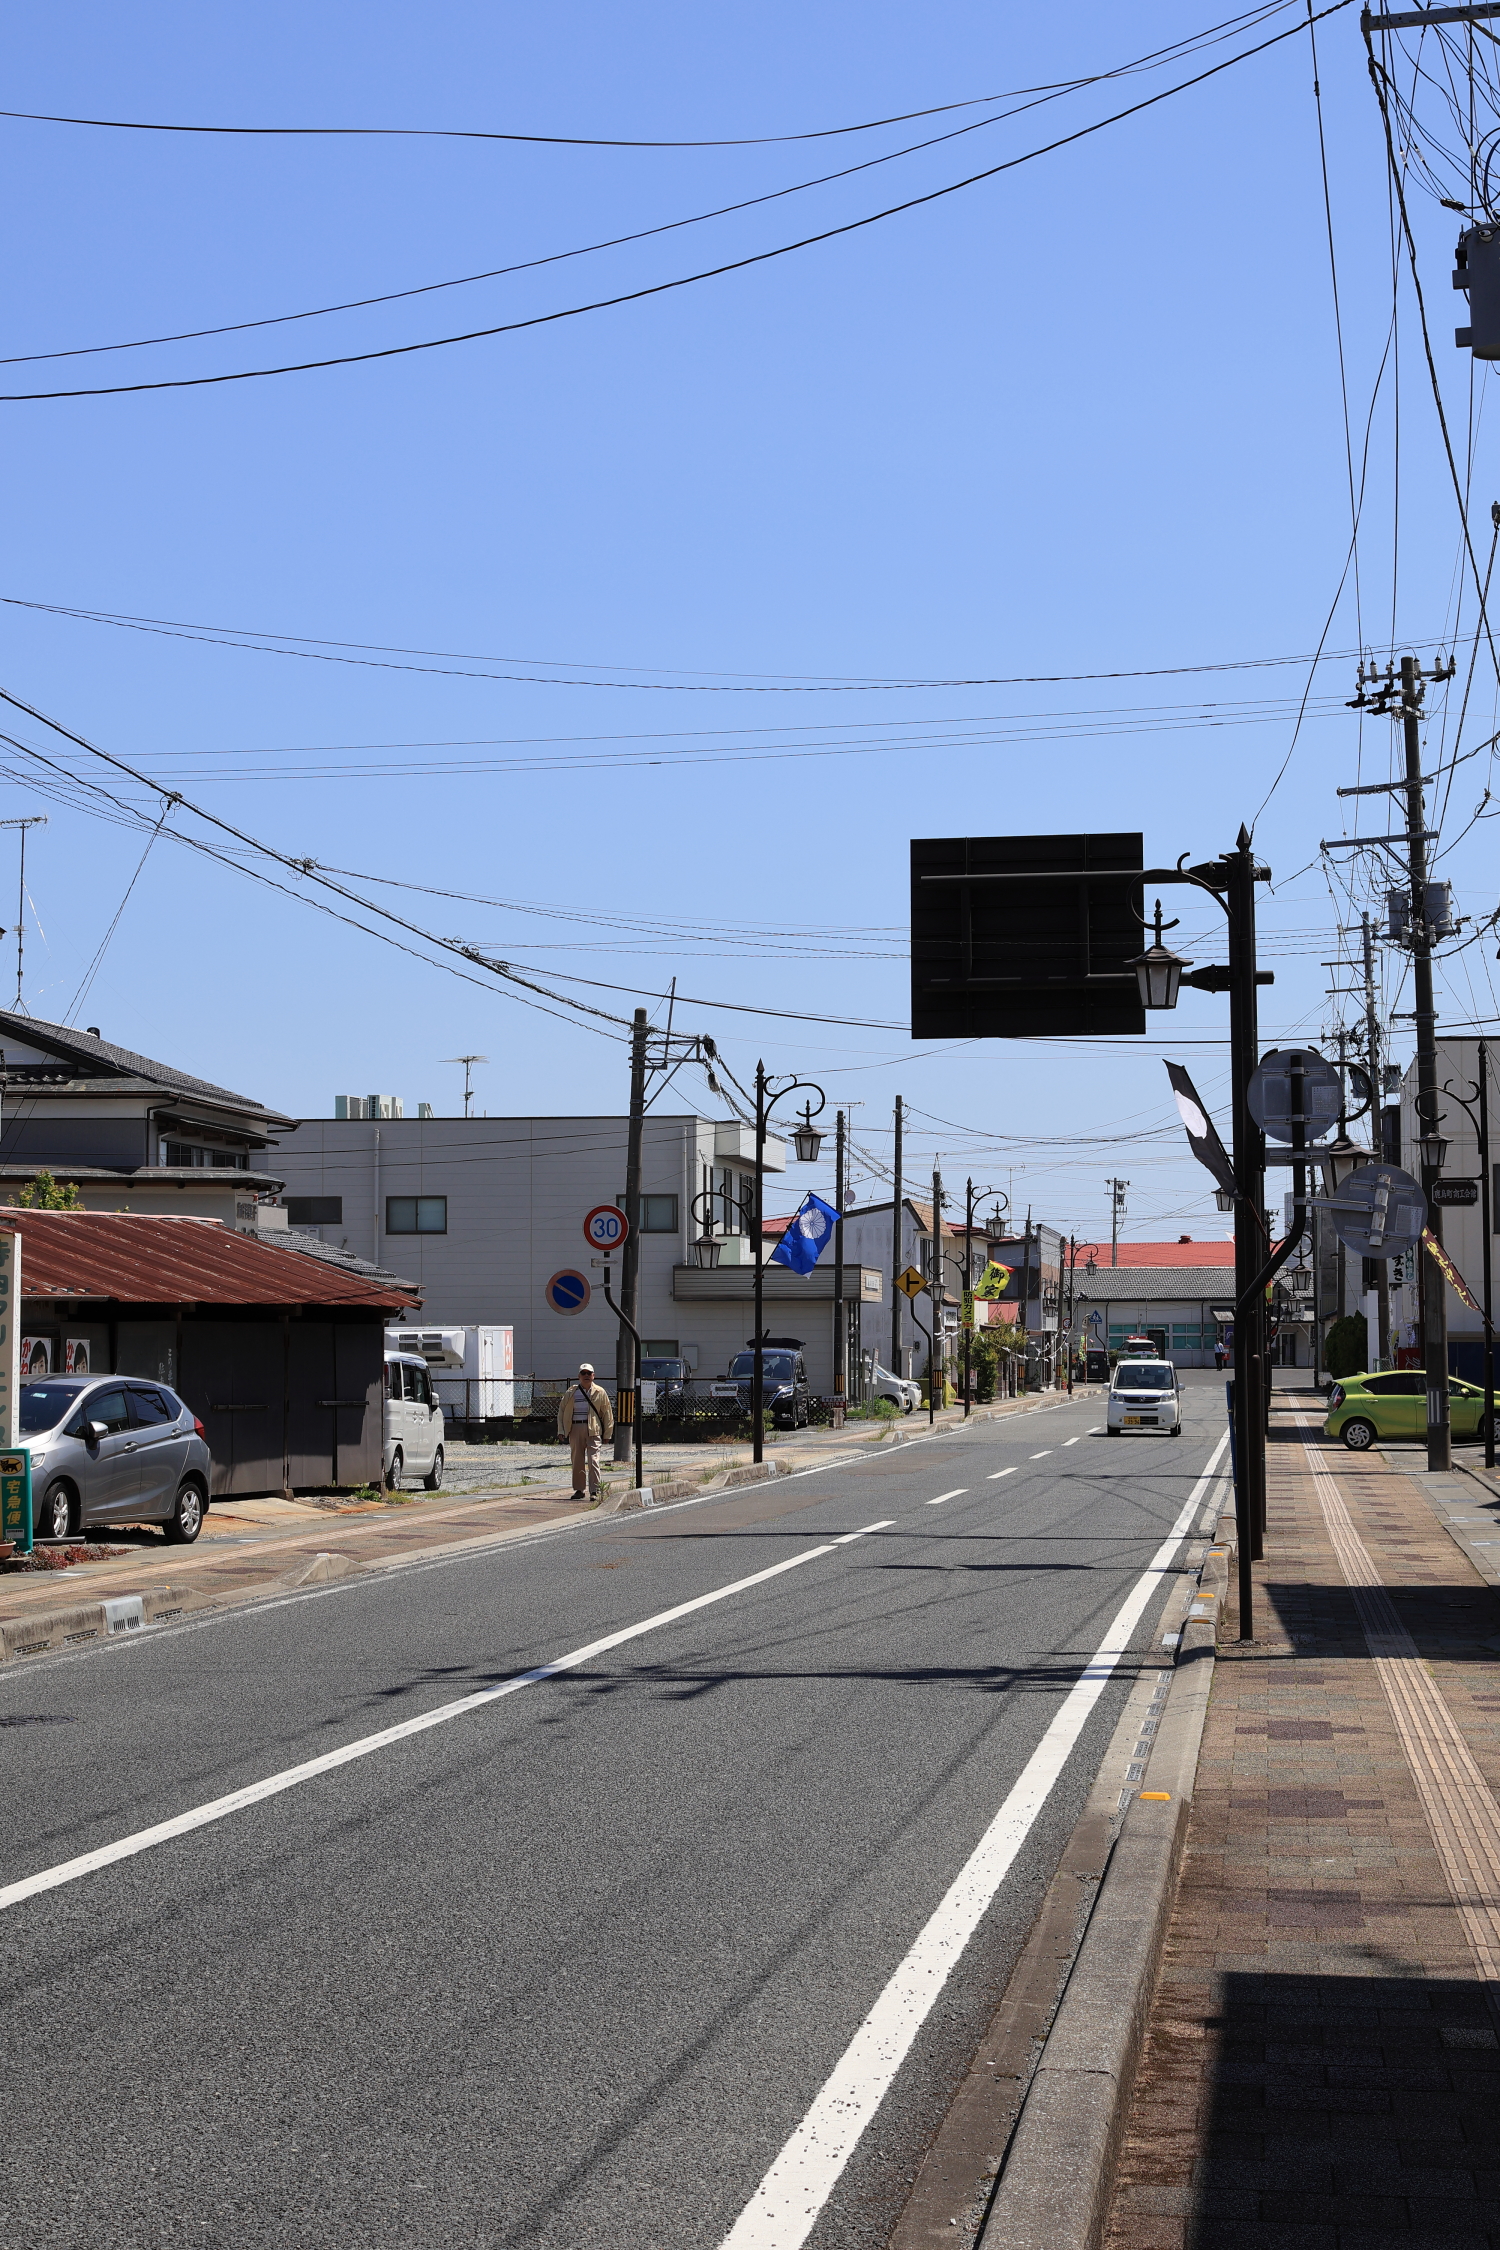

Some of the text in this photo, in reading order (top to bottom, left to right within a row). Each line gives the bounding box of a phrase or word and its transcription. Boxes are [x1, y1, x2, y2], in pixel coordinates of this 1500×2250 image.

[594, 1218, 618, 1238] 30
[963, 1291, 973, 1322] 防犯カメラ
[6, 1480, 21, 1525] 宅急便
